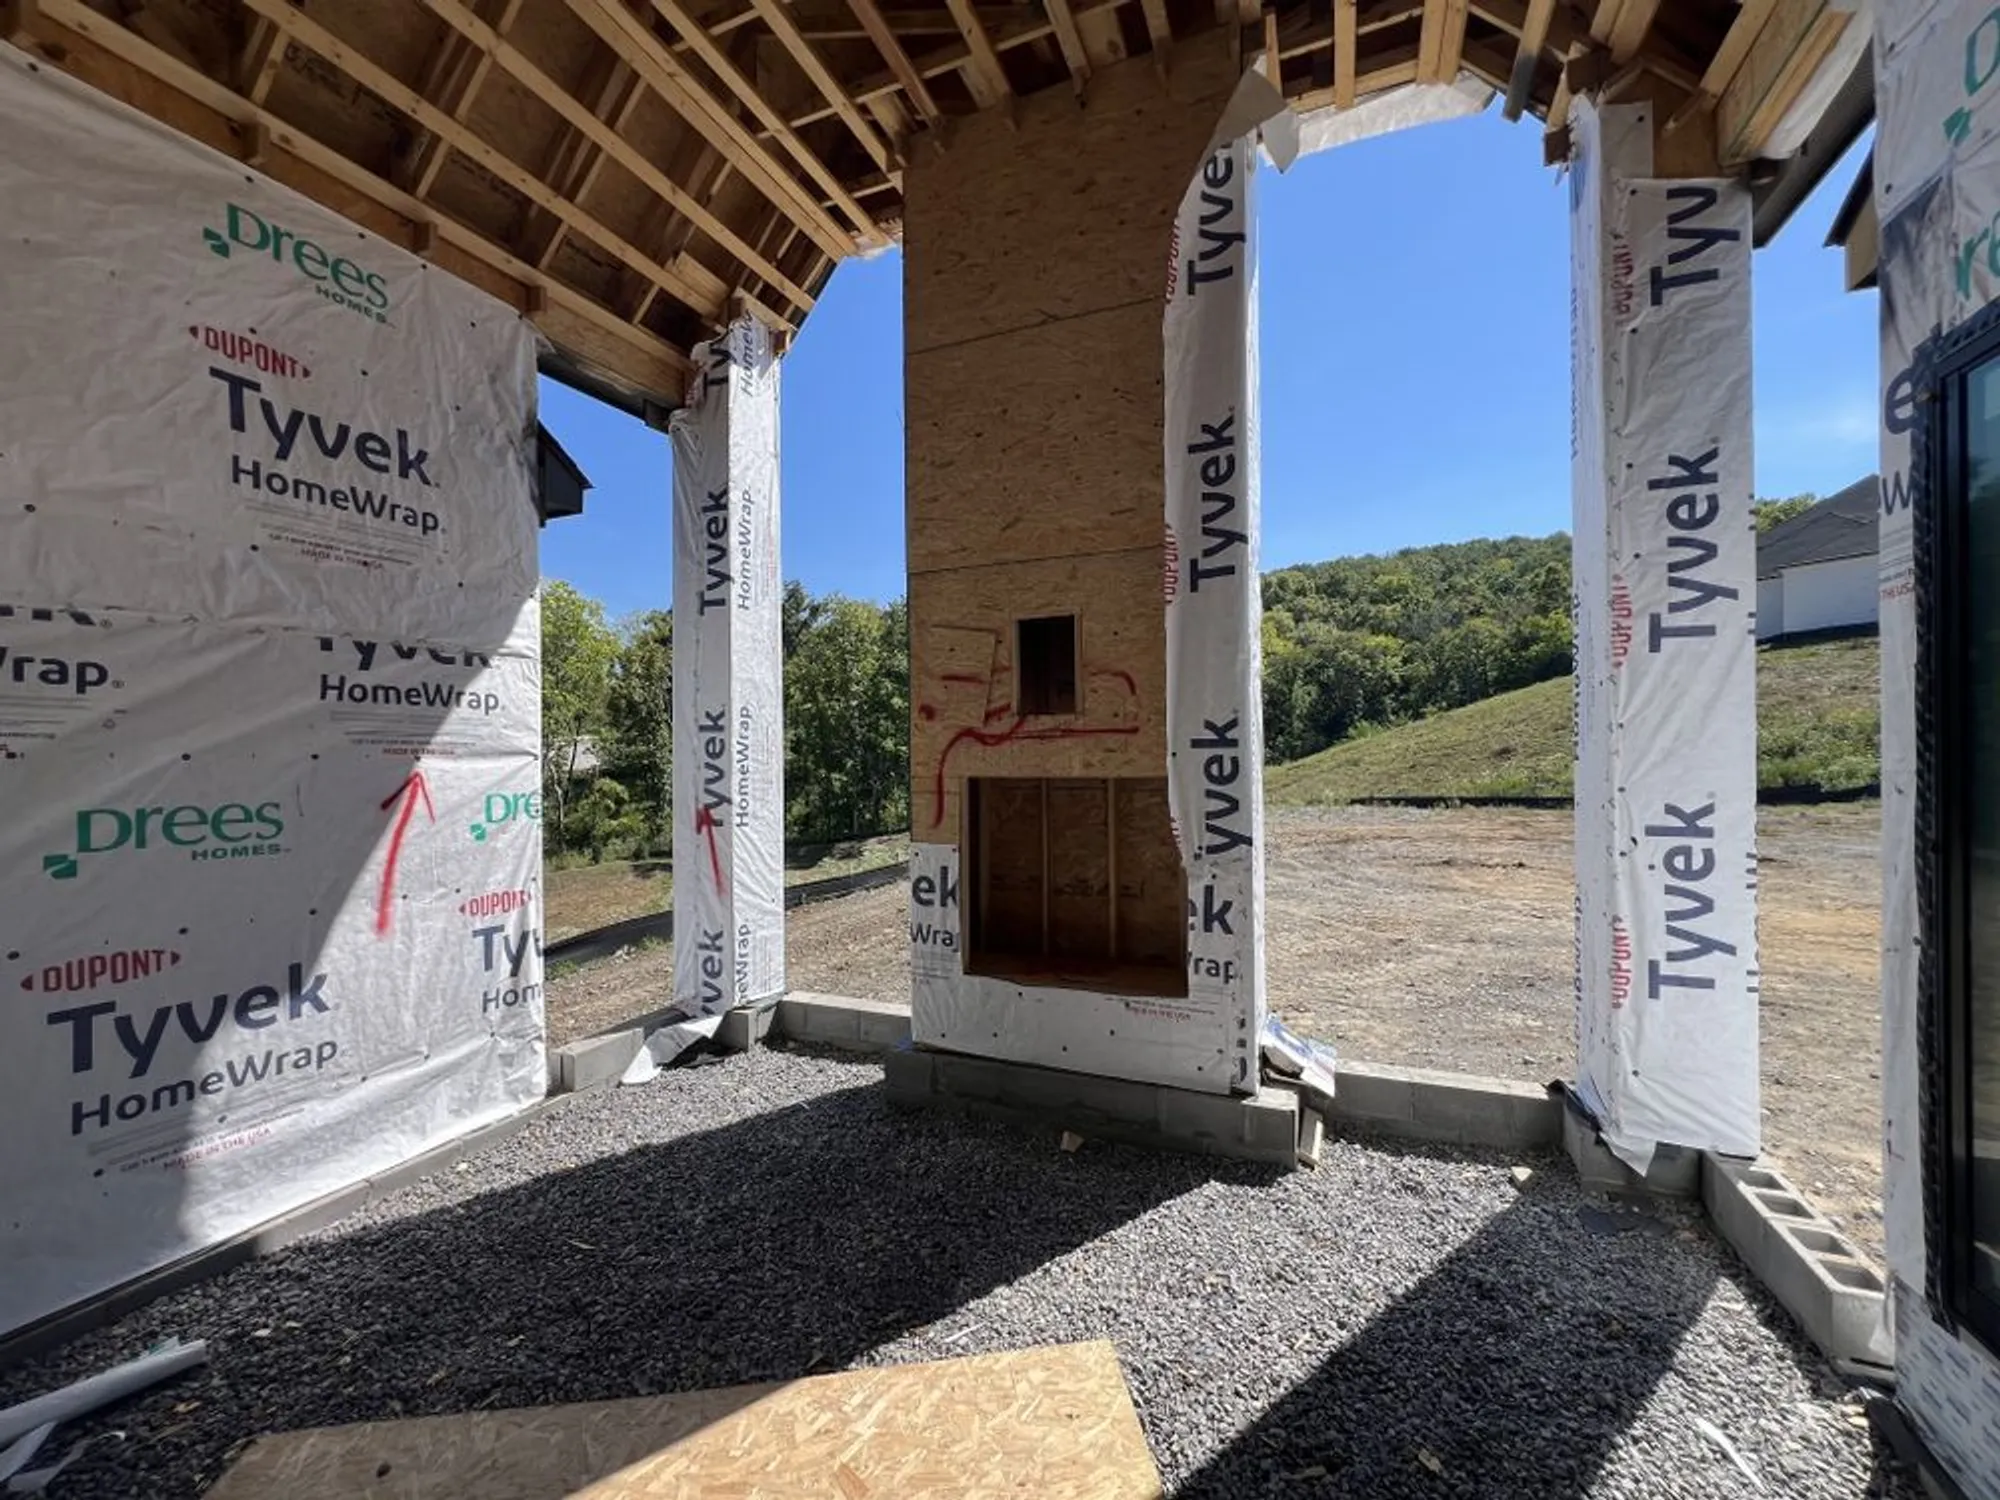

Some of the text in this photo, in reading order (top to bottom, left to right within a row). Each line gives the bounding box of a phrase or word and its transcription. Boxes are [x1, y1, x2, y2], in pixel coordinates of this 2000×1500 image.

[226, 203, 389, 309] Drees
[1187, 142, 1247, 296] Tyve
[204, 326, 299, 379] DUPONT
[315, 284, 388, 324] HOMES
[209, 367, 432, 488] Tyvek
[232, 455, 440, 534] HomeWrap
[1188, 415, 1249, 593] Tyvek
[700, 483, 734, 616] Tyvek
[1648, 447, 1739, 653] Tyvek
[0, 646, 109, 695] rap
[320, 674, 500, 715] HomeWrap
[736, 706, 752, 828] HomeWrap
[1190, 718, 1252, 861] yvek
[76, 802, 284, 853] Drees
[192, 844, 280, 861] HOMES
[469, 890, 526, 917] DUPONT
[1644, 802, 1738, 1000] Tyvek
[43, 949, 164, 993] DUPONT
[47, 961, 332, 1078] Tyvek
[71, 1039, 338, 1135] HomeWrap
